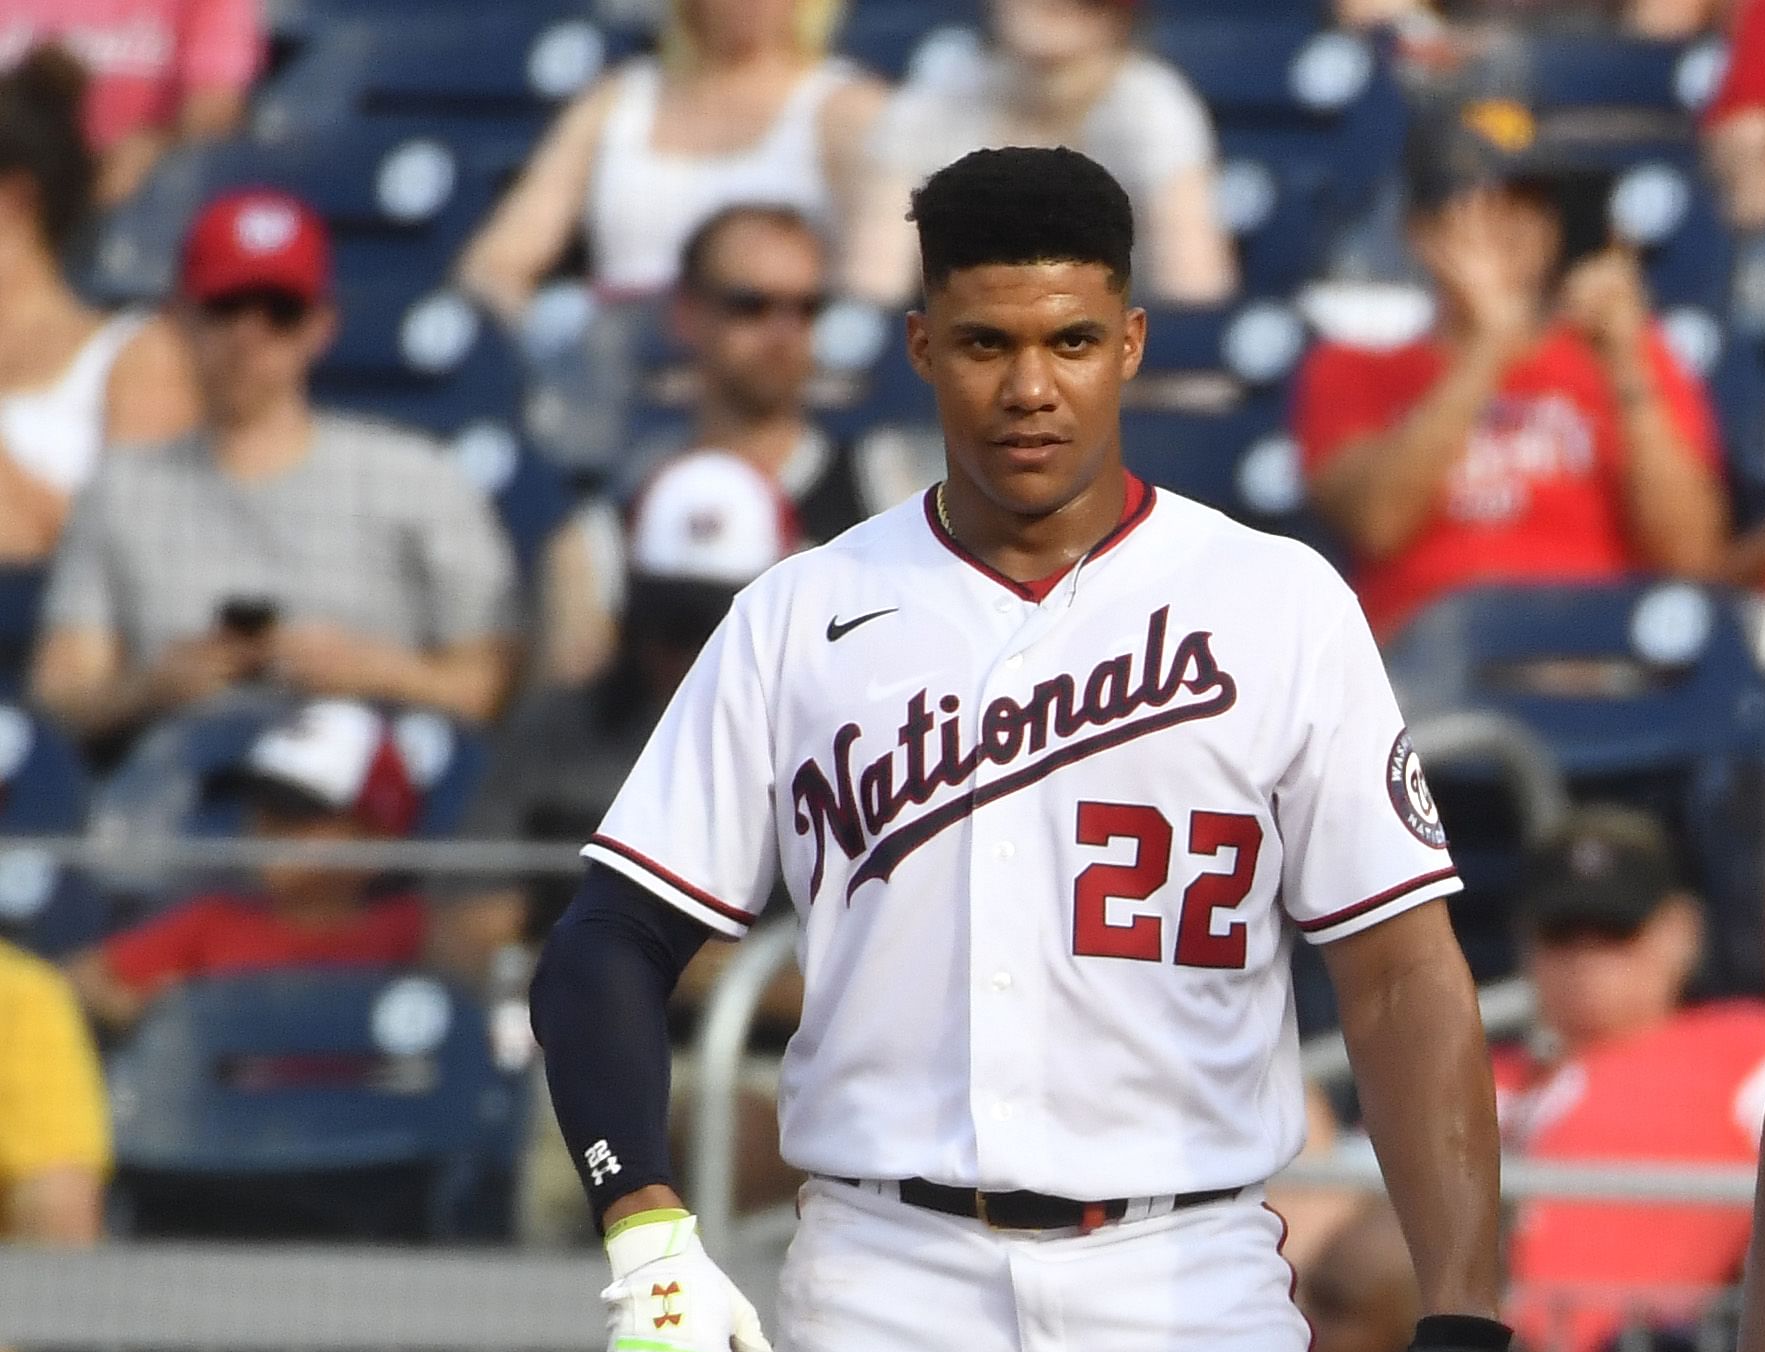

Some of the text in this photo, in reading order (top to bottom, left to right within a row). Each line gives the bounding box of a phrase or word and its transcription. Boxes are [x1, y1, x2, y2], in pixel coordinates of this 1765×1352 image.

[792, 604, 1237, 908] Nationals
[1073, 801, 1264, 969] 22
[584, 1139, 611, 1169] 22
